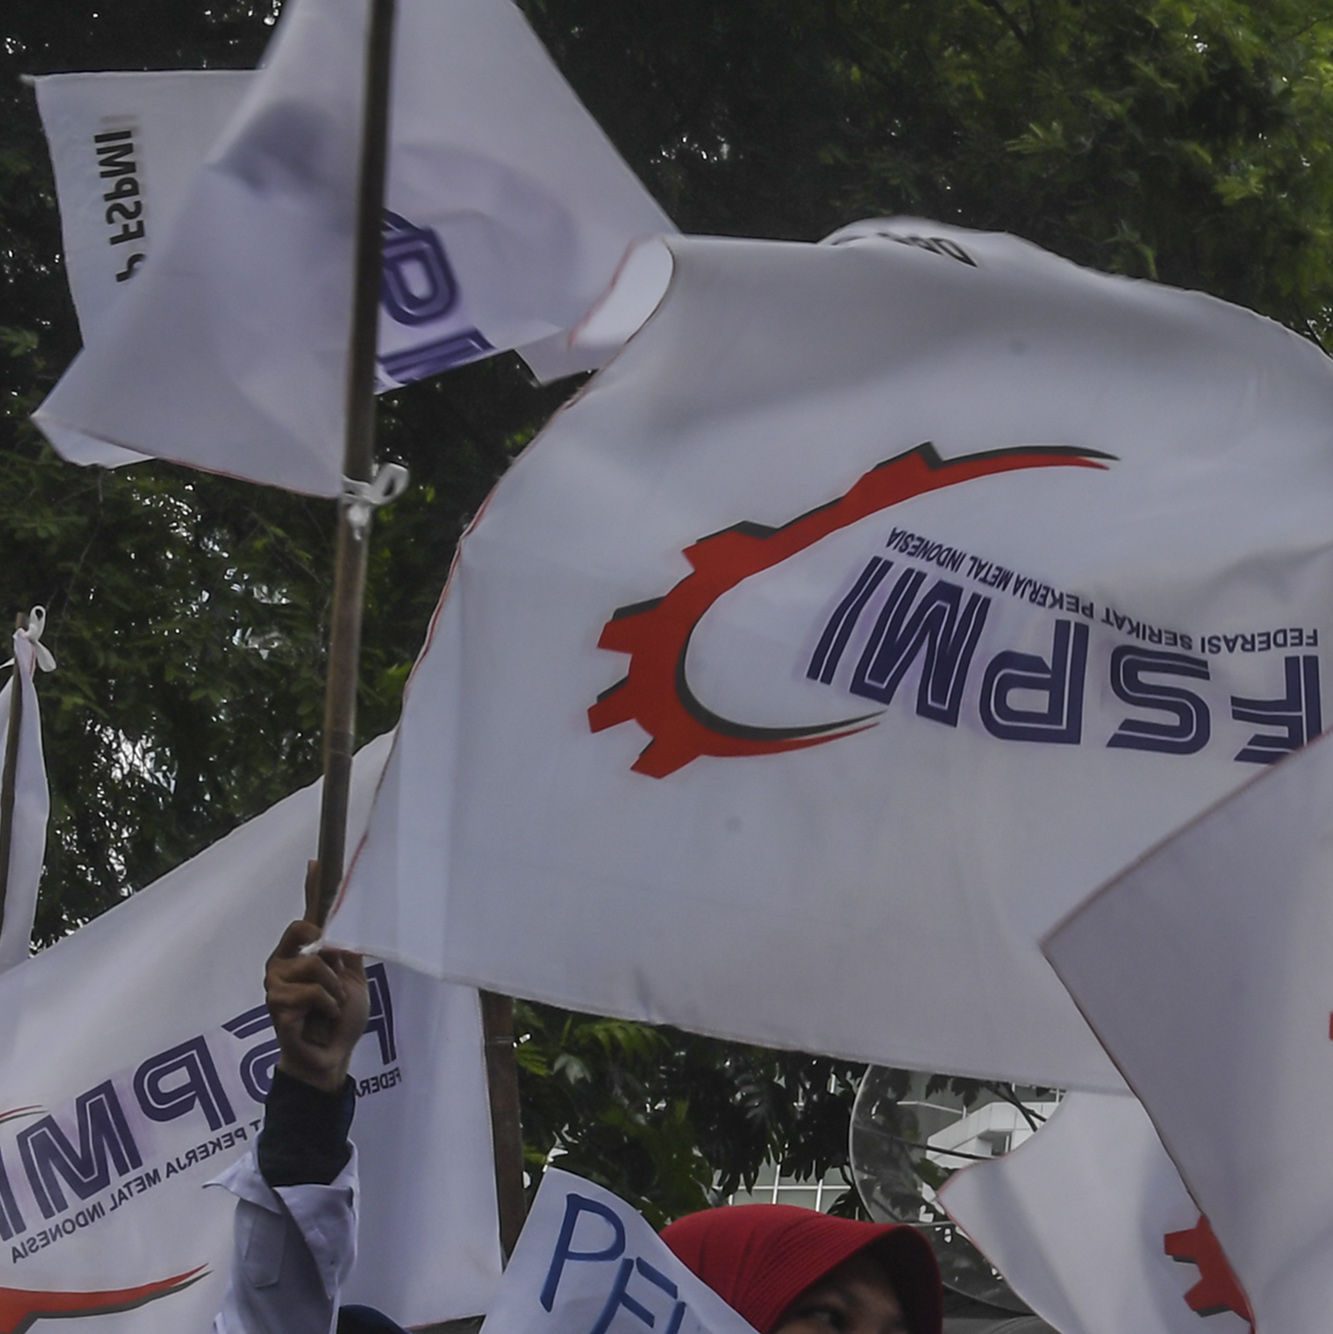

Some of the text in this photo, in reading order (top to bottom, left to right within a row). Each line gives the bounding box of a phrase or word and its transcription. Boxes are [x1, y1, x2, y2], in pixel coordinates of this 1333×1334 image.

[806, 555, 1323, 766] FSPMI
[886, 527, 1319, 654] FEDERASI SERIKAT PEKERJA METAL INDONESIA
